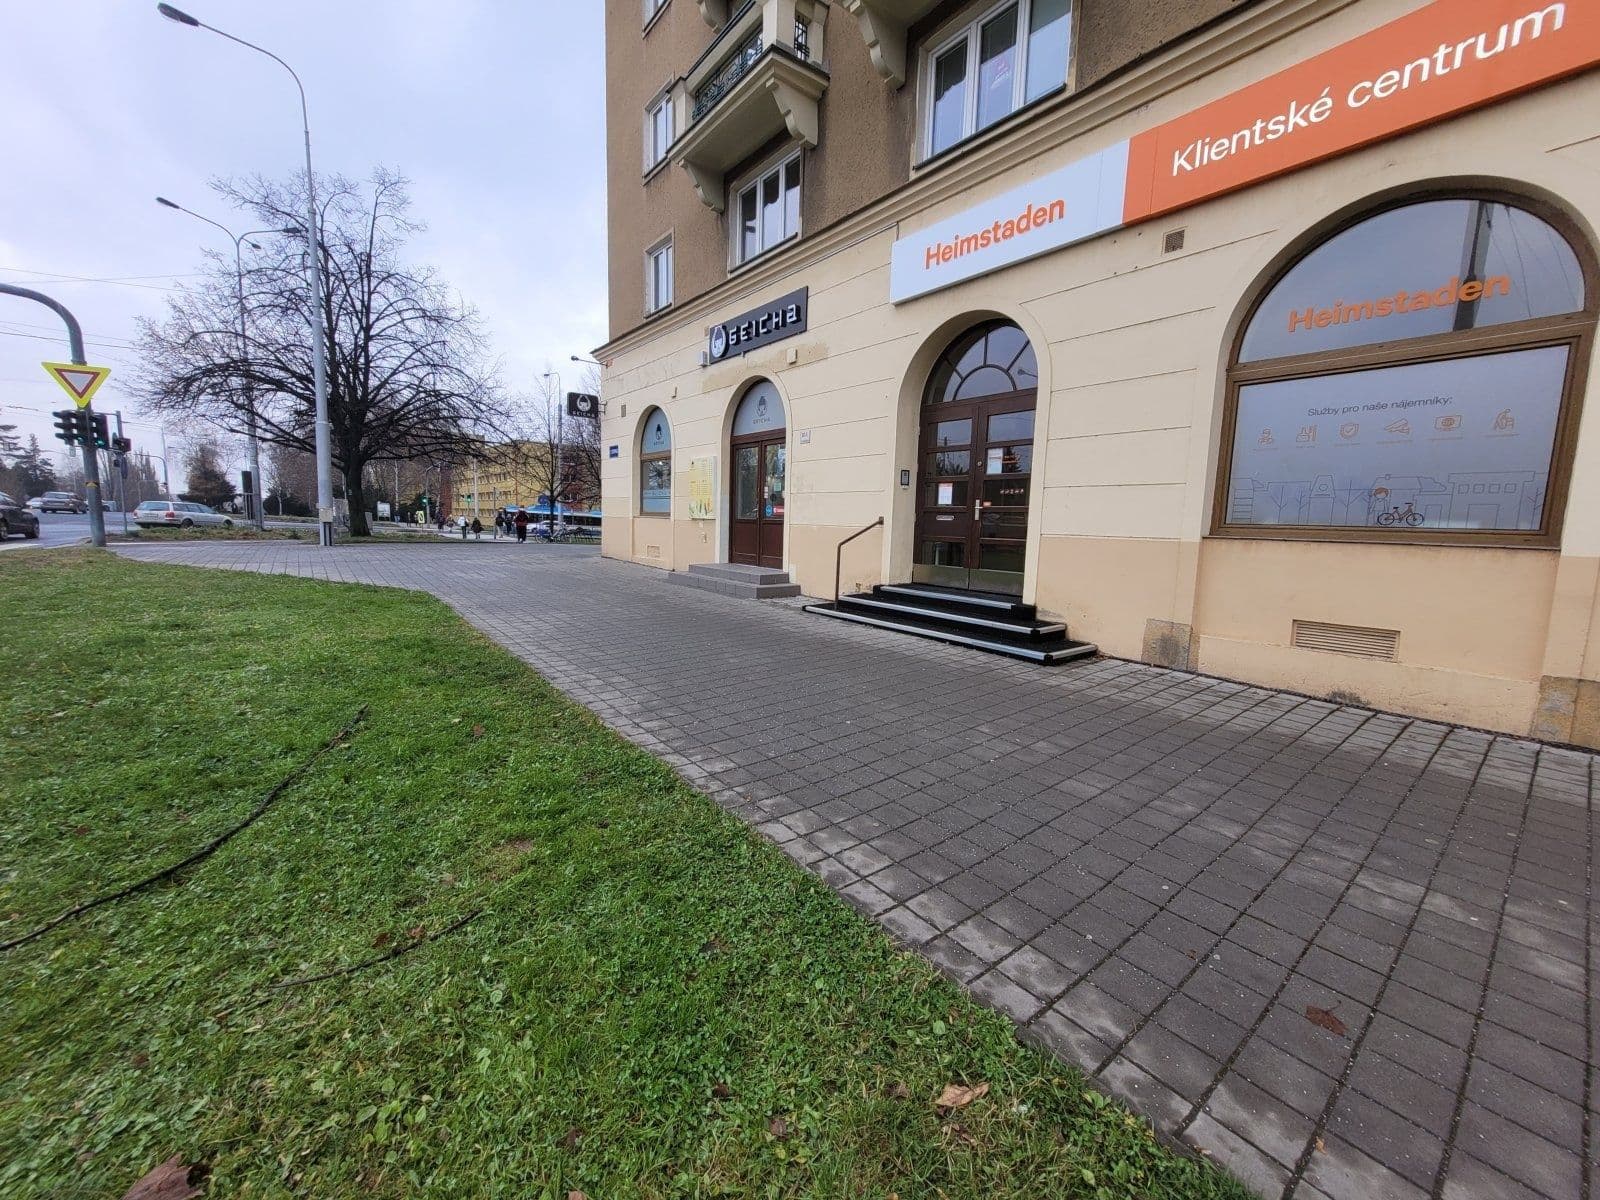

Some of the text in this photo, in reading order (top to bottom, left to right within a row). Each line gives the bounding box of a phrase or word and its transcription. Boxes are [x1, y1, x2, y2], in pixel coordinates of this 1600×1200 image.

[1171, 2, 1567, 177] Klientské centrum
[924, 198, 1065, 270] Heimstaden
[1287, 274, 1511, 333] Heimstaden
[1307, 407, 1340, 417] Služby
[1341, 405, 1360, 414] pro
[1362, 401, 1389, 412] naše
